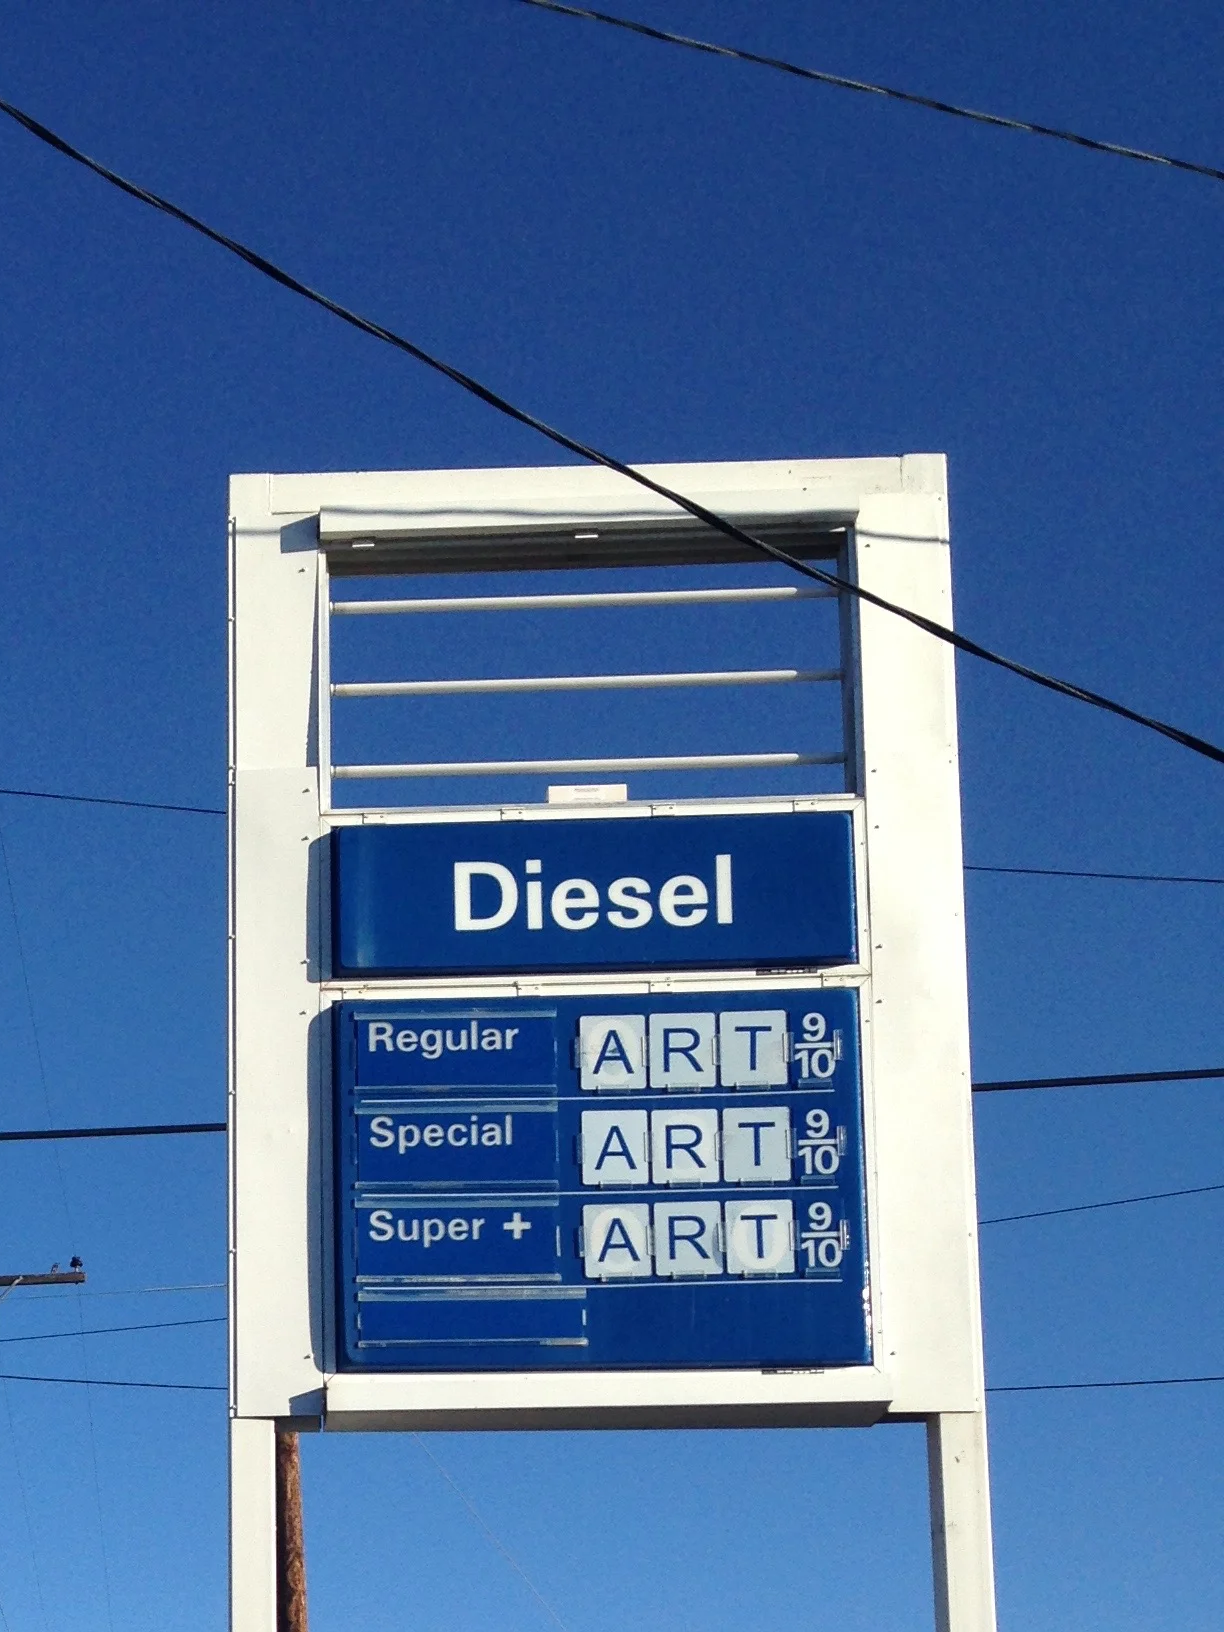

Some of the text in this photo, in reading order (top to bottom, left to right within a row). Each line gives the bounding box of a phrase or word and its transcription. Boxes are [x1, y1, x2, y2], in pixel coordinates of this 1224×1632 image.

[453, 853, 734, 931] Diesel
[367, 1019, 520, 1060] Regular
[369, 1113, 513, 1155] Special
[369, 1209, 532, 1249] Super +
